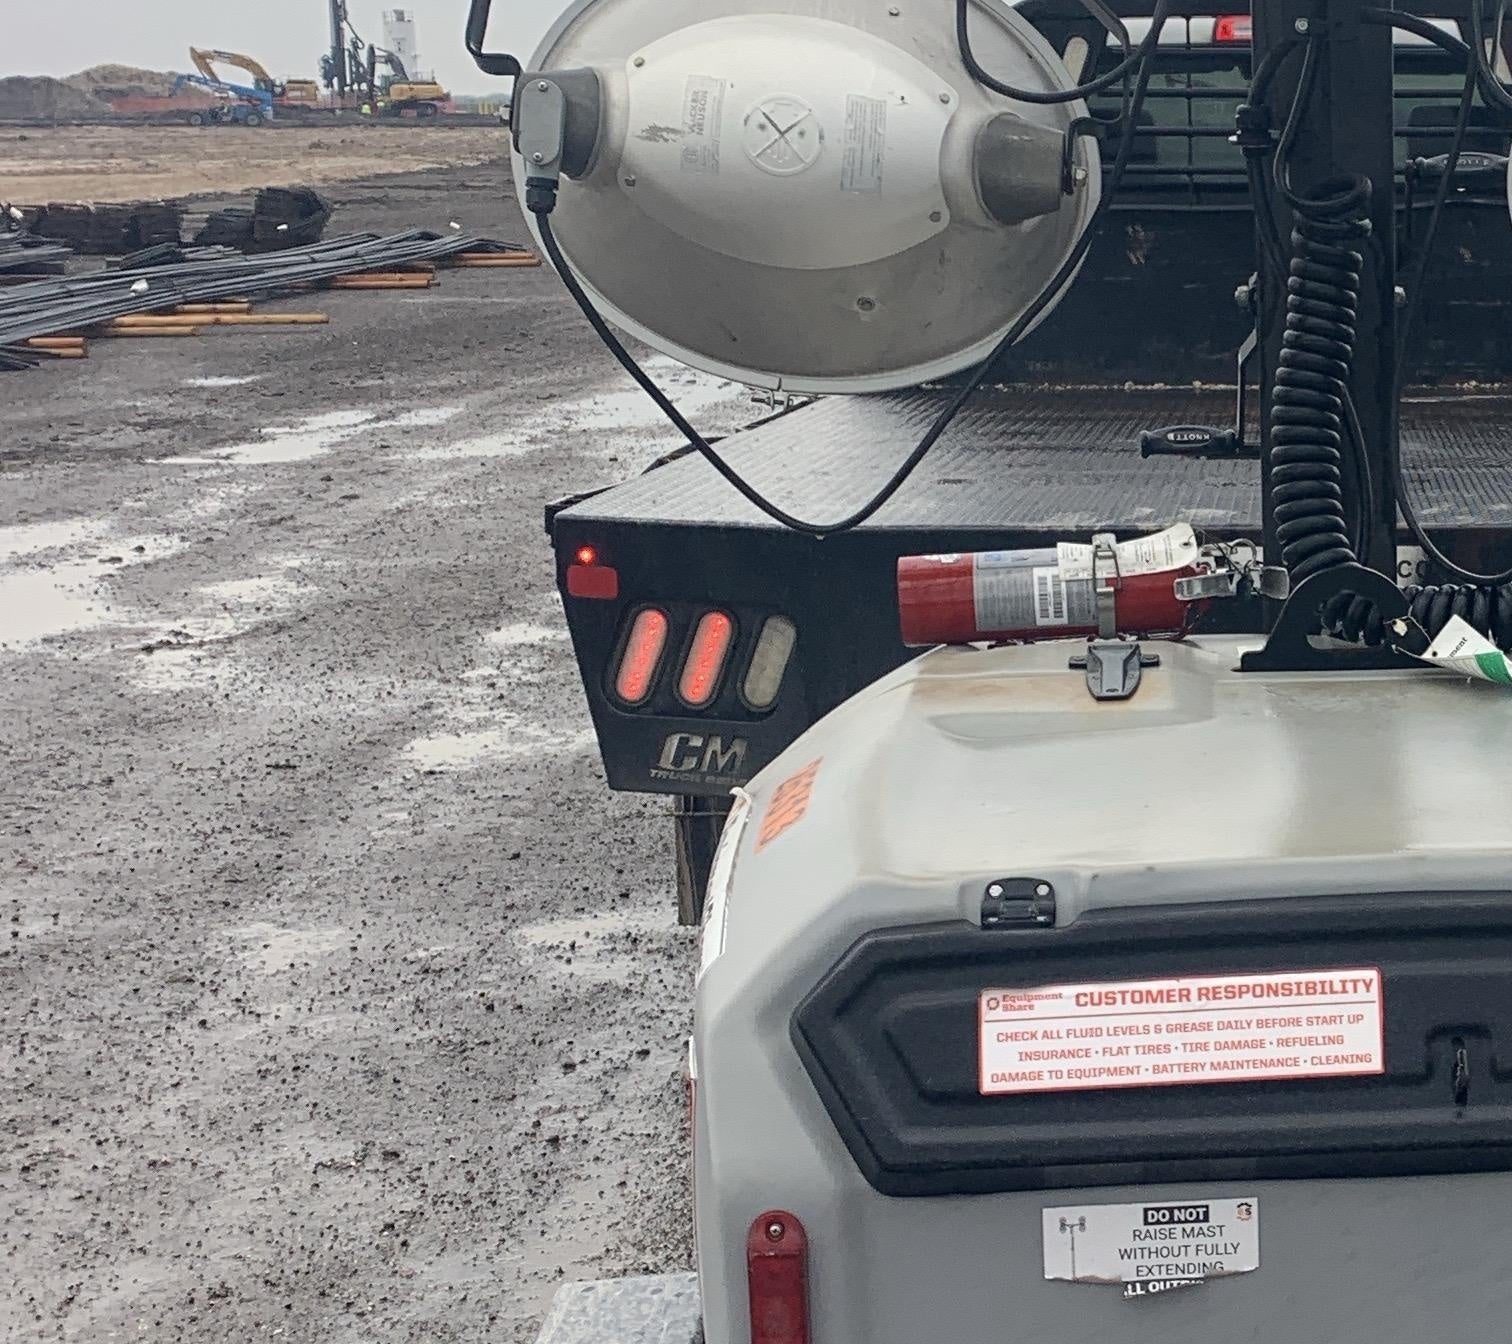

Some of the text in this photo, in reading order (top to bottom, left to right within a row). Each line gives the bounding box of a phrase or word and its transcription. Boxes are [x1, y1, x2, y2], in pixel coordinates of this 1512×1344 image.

[658, 733, 748, 772] CM
[1002, 992, 1063, 1003] Equipment
[1075, 978, 1374, 1007] CUSTOMER RESPONSIBILITY
[1002, 1002, 1035, 1012] Share
[997, 1030, 1038, 1043] CHECK
[1041, 1029, 1063, 1041] ALL
[1066, 1027, 1103, 1039] FLUID
[1107, 1025, 1150, 1037] LEVELS
[1166, 1020, 1213, 1033] GREASE
[1217, 1019, 1253, 1031] DAILY
[1256, 1017, 1302, 1029] BEFORE
[1307, 1014, 1344, 1027] START
[1347, 1014, 1364, 1024] UP
[1018, 1035, 1344, 1062] INSURANCE FLAT TIRES TIRE DAMAGE REFUELING
[991, 1053, 1372, 1084] DAMAGE TO EQUIPMENT BATTERY MAINTENANCE CLEANING
[1147, 1208, 1207, 1223] DO NOT
[1132, 1225, 1225, 1241] RAISE MAST
[1119, 1242, 1240, 1260] WITHOUT FULLY
[1136, 1261, 1224, 1277] EXTENDING
[1124, 1282, 1145, 1296] LL
